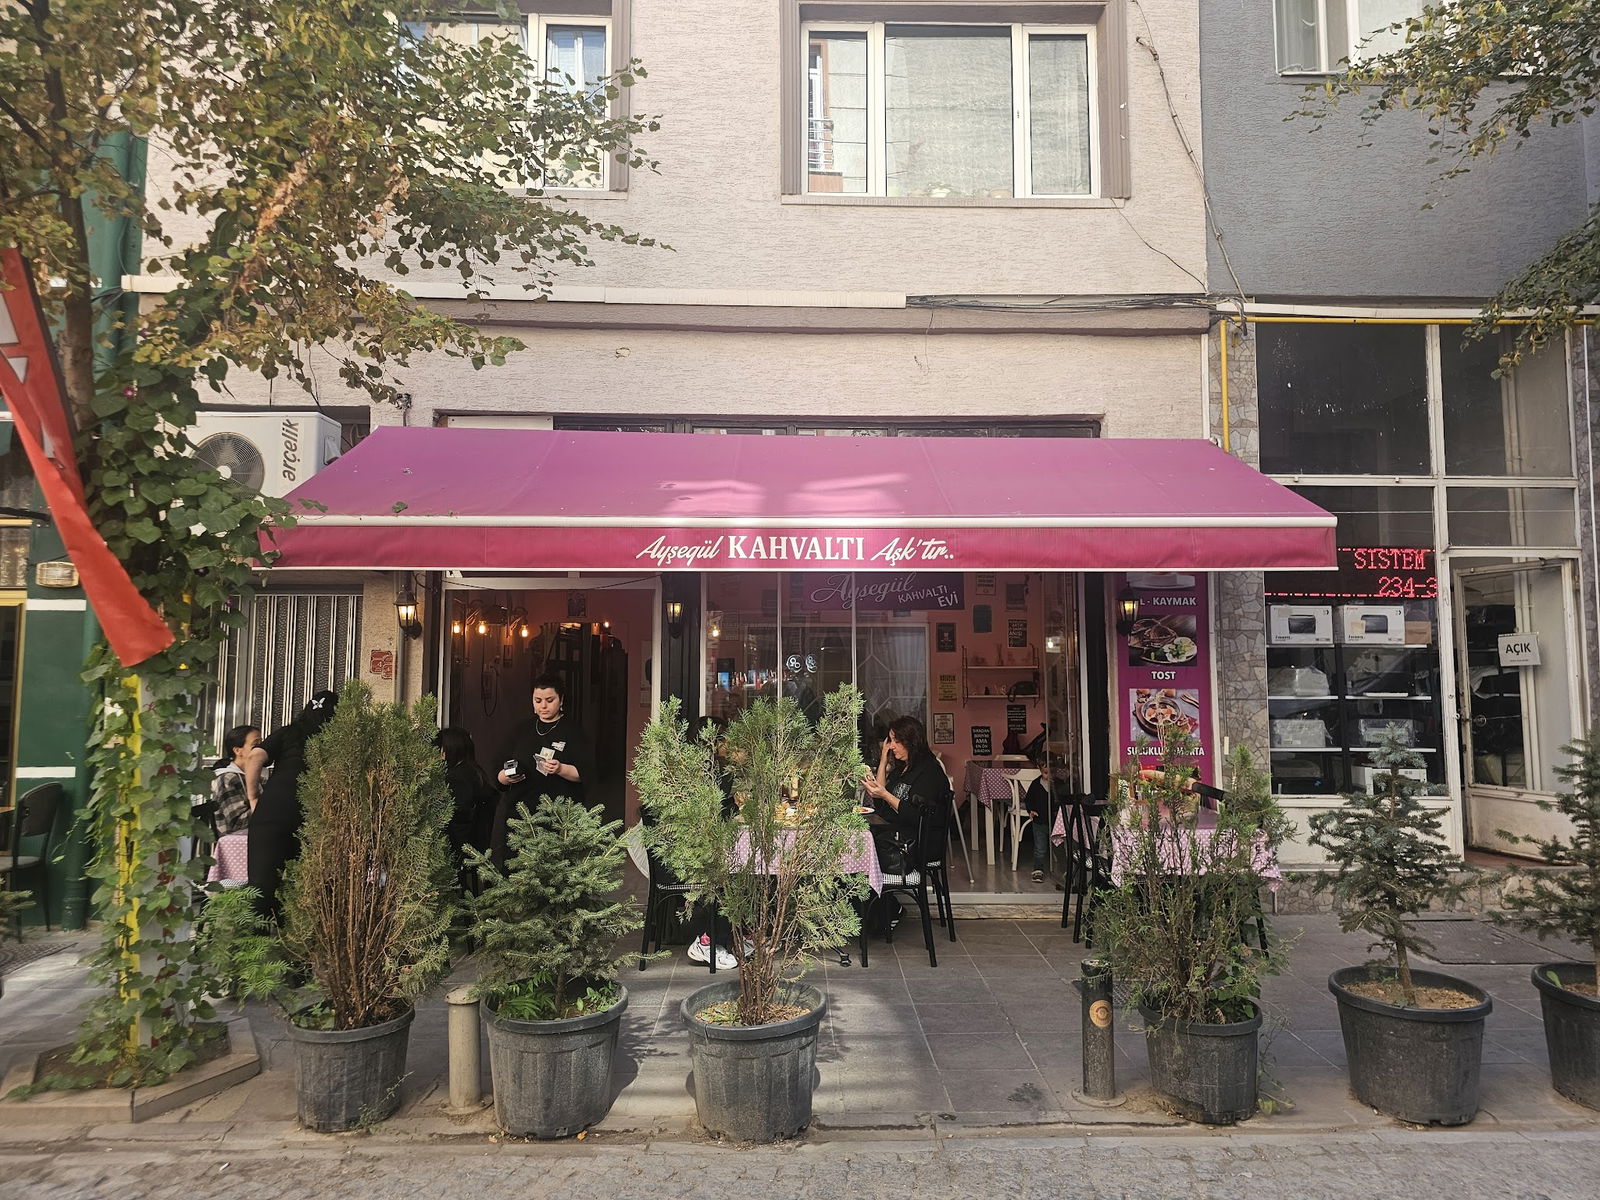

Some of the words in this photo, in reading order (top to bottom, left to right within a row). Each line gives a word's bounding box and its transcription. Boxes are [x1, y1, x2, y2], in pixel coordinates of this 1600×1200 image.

[281, 418, 301, 482] arçelik
[635, 535, 724, 567] Ayşegül
[727, 535, 865, 560] KAHVALTI
[810, 571, 918, 610] Ayşegül
[898, 585, 948, 604] KAHVALTI
[937, 591, 959, 608] EVİ
[1153, 597, 1197, 606] KAYMAK
[1505, 642, 1531, 656] AÇIK
[1151, 671, 1176, 680] TOST
[1127, 746, 1164, 756] SUUKLU
